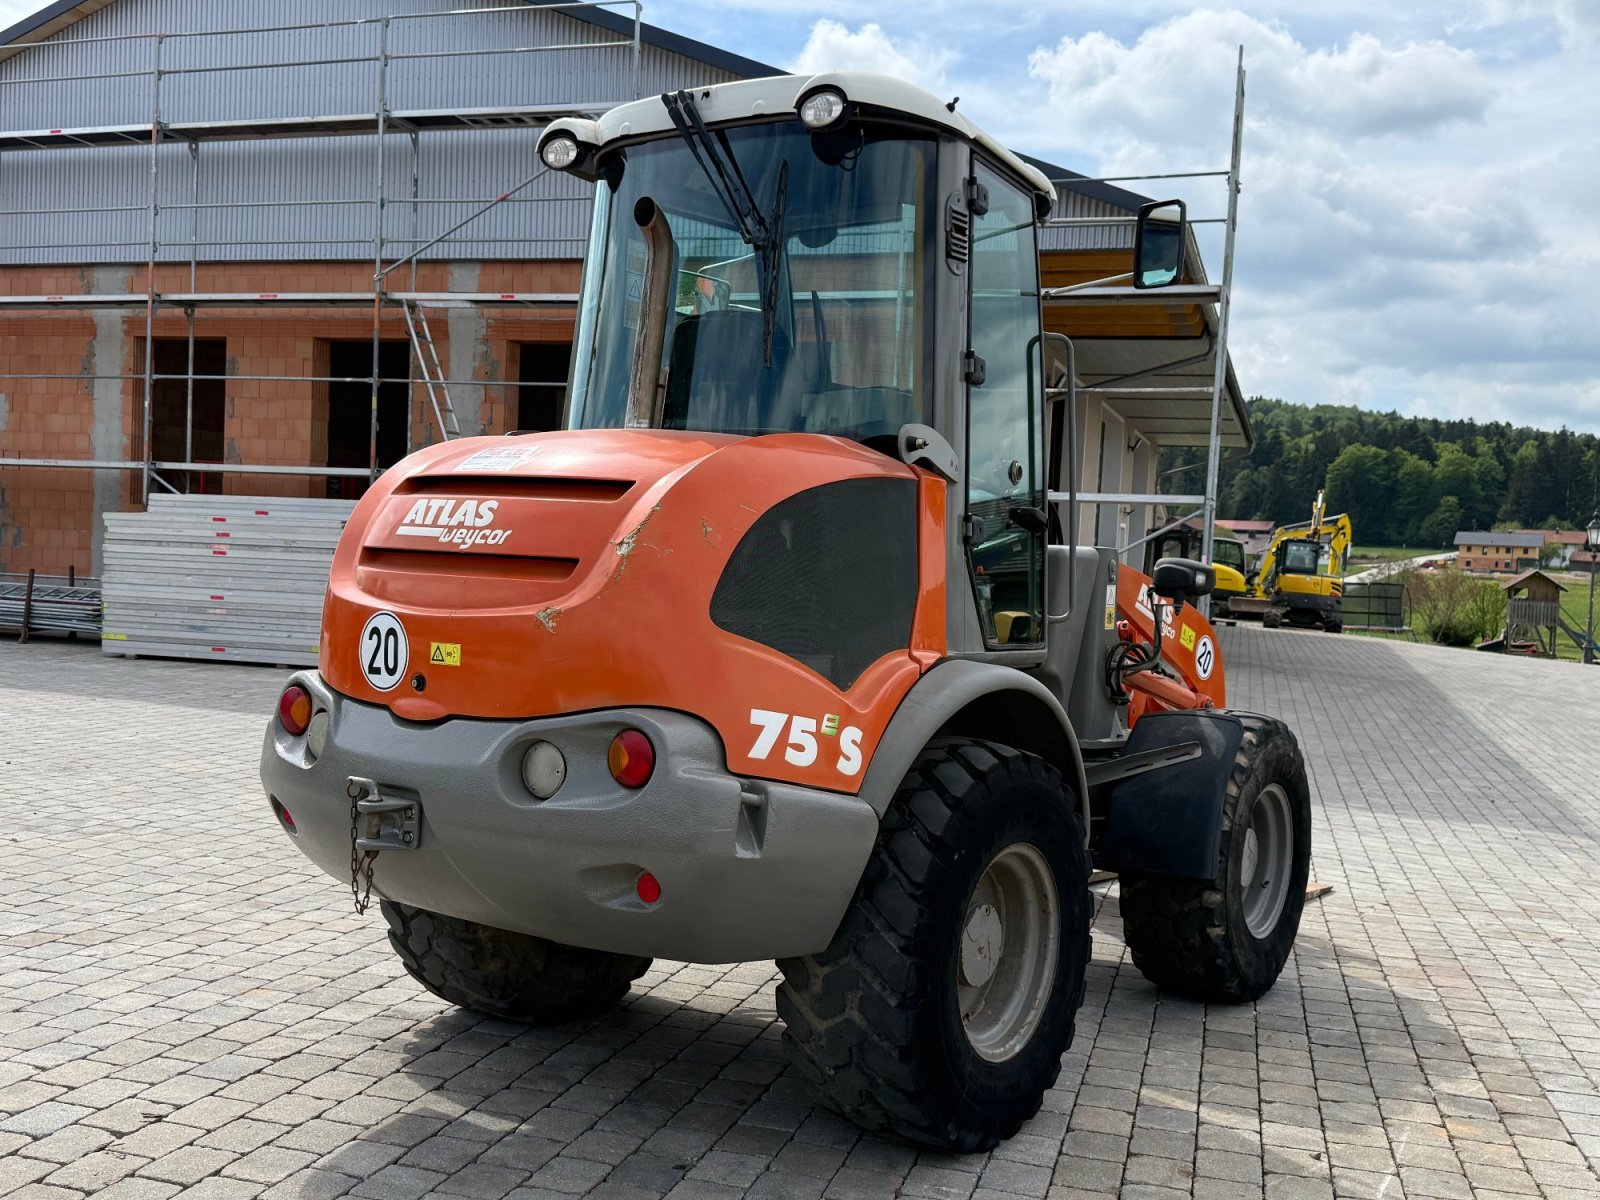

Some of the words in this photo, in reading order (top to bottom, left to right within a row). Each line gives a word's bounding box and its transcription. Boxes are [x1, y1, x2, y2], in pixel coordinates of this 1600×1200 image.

[402, 499, 499, 527] ATLAS
[438, 528, 513, 549] weycor
[368, 626, 399, 676] 20
[1197, 641, 1212, 675] 20
